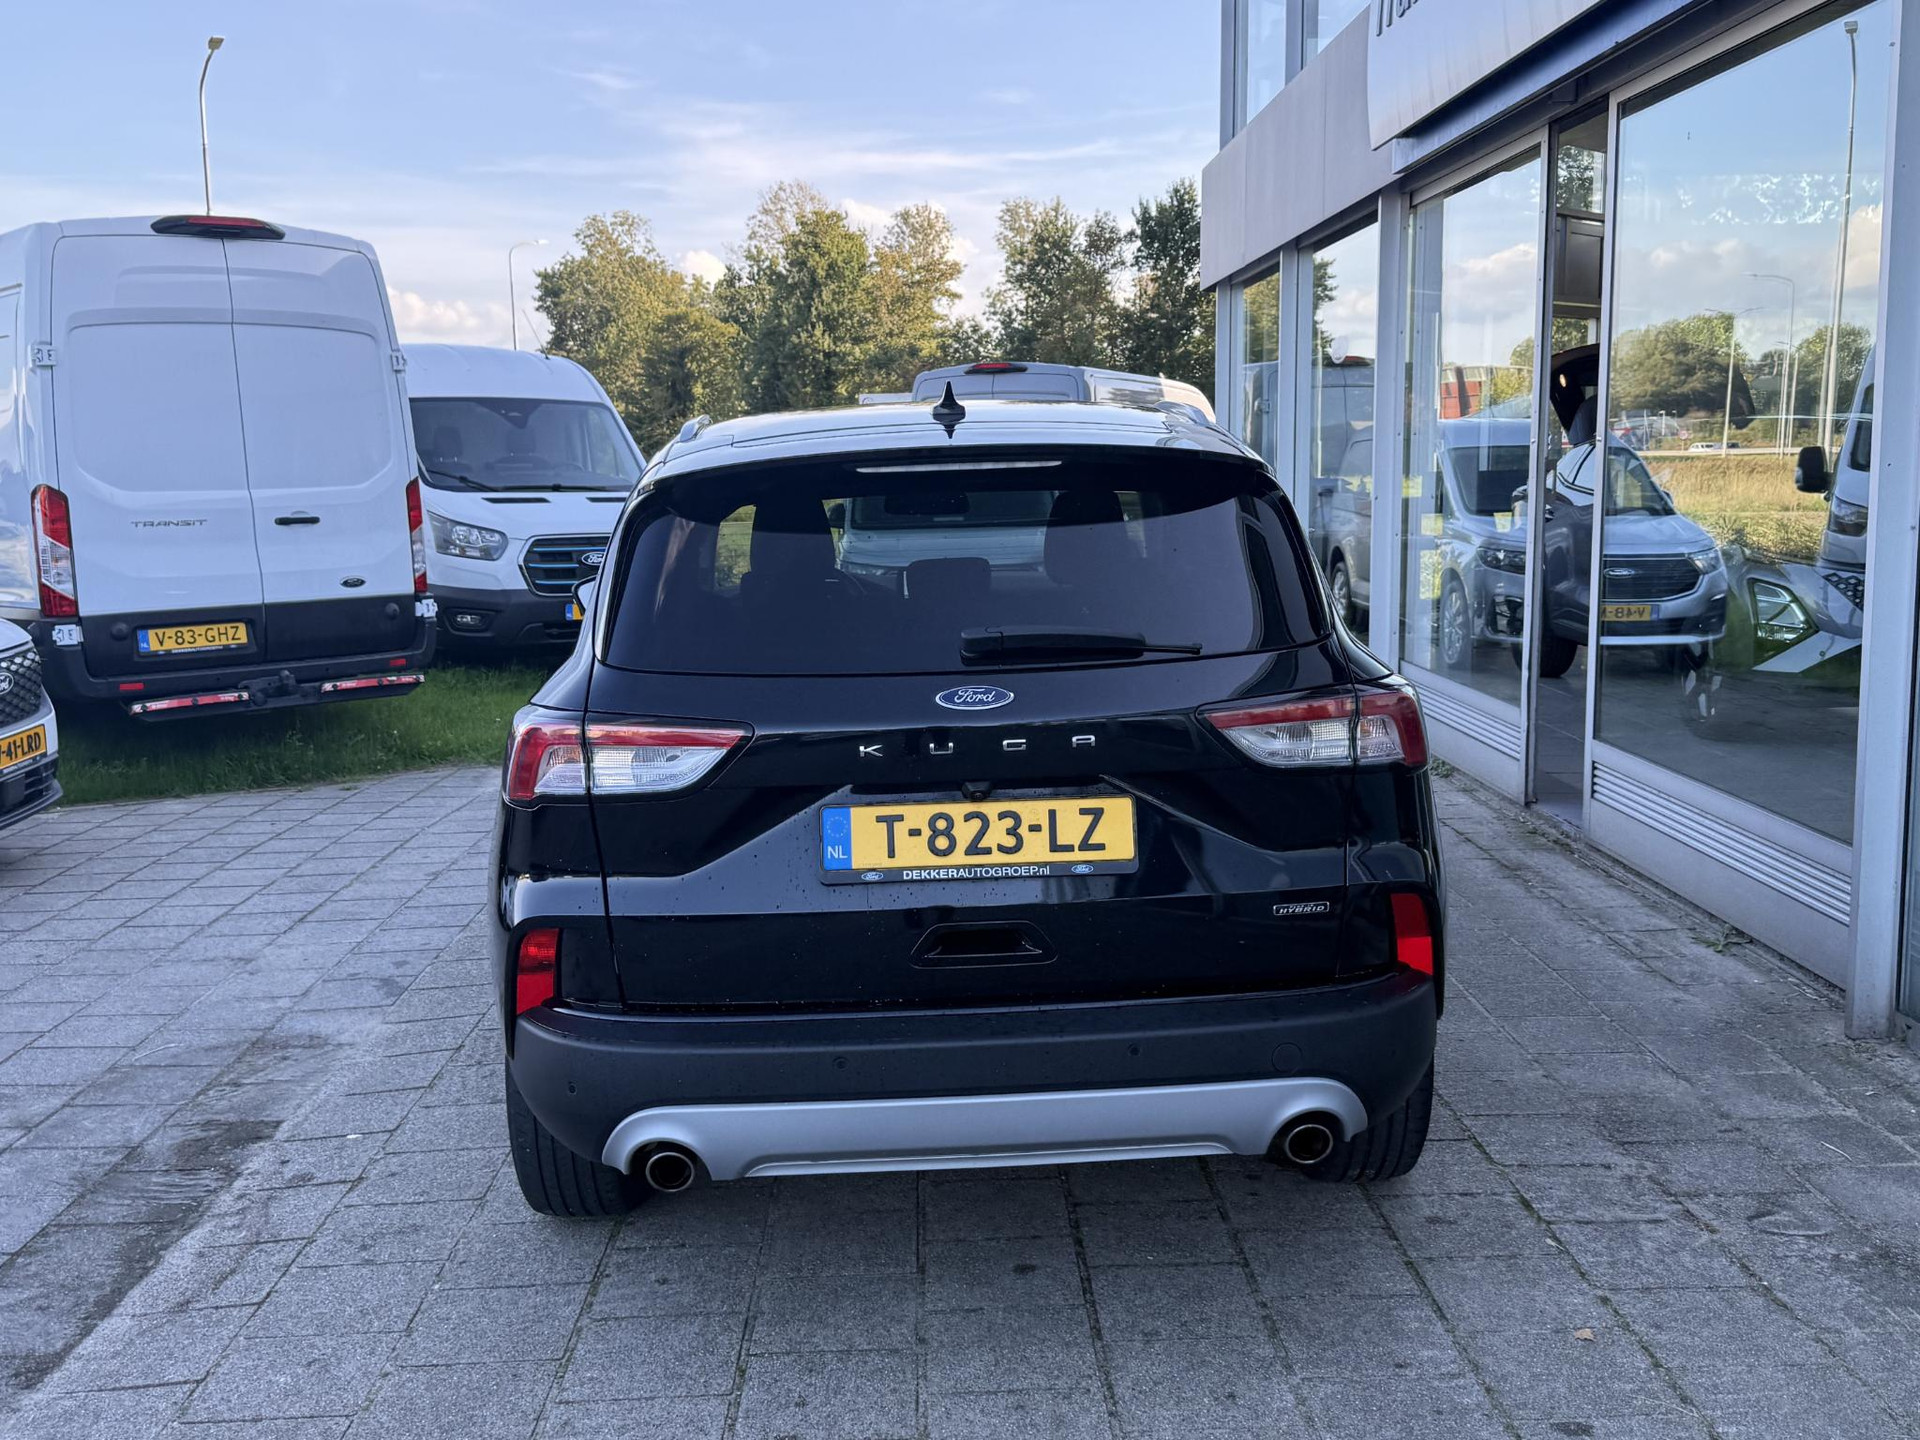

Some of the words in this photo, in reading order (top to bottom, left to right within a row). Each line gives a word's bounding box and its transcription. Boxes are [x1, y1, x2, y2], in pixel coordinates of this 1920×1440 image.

[131, 519, 207, 527] TRANSIT
[155, 626, 241, 647] V-83-GHZ
[953, 686, 997, 704] Ford
[0, 732, 41, 763] -41-LRD
[860, 734, 1096, 757] KUGA
[876, 807, 1106, 859] T-823-LZ
[827, 845, 848, 859] NL
[903, 865, 1050, 880] DEKKERAUTOGROEP.nl
[1279, 905, 1325, 914] HYBRID
